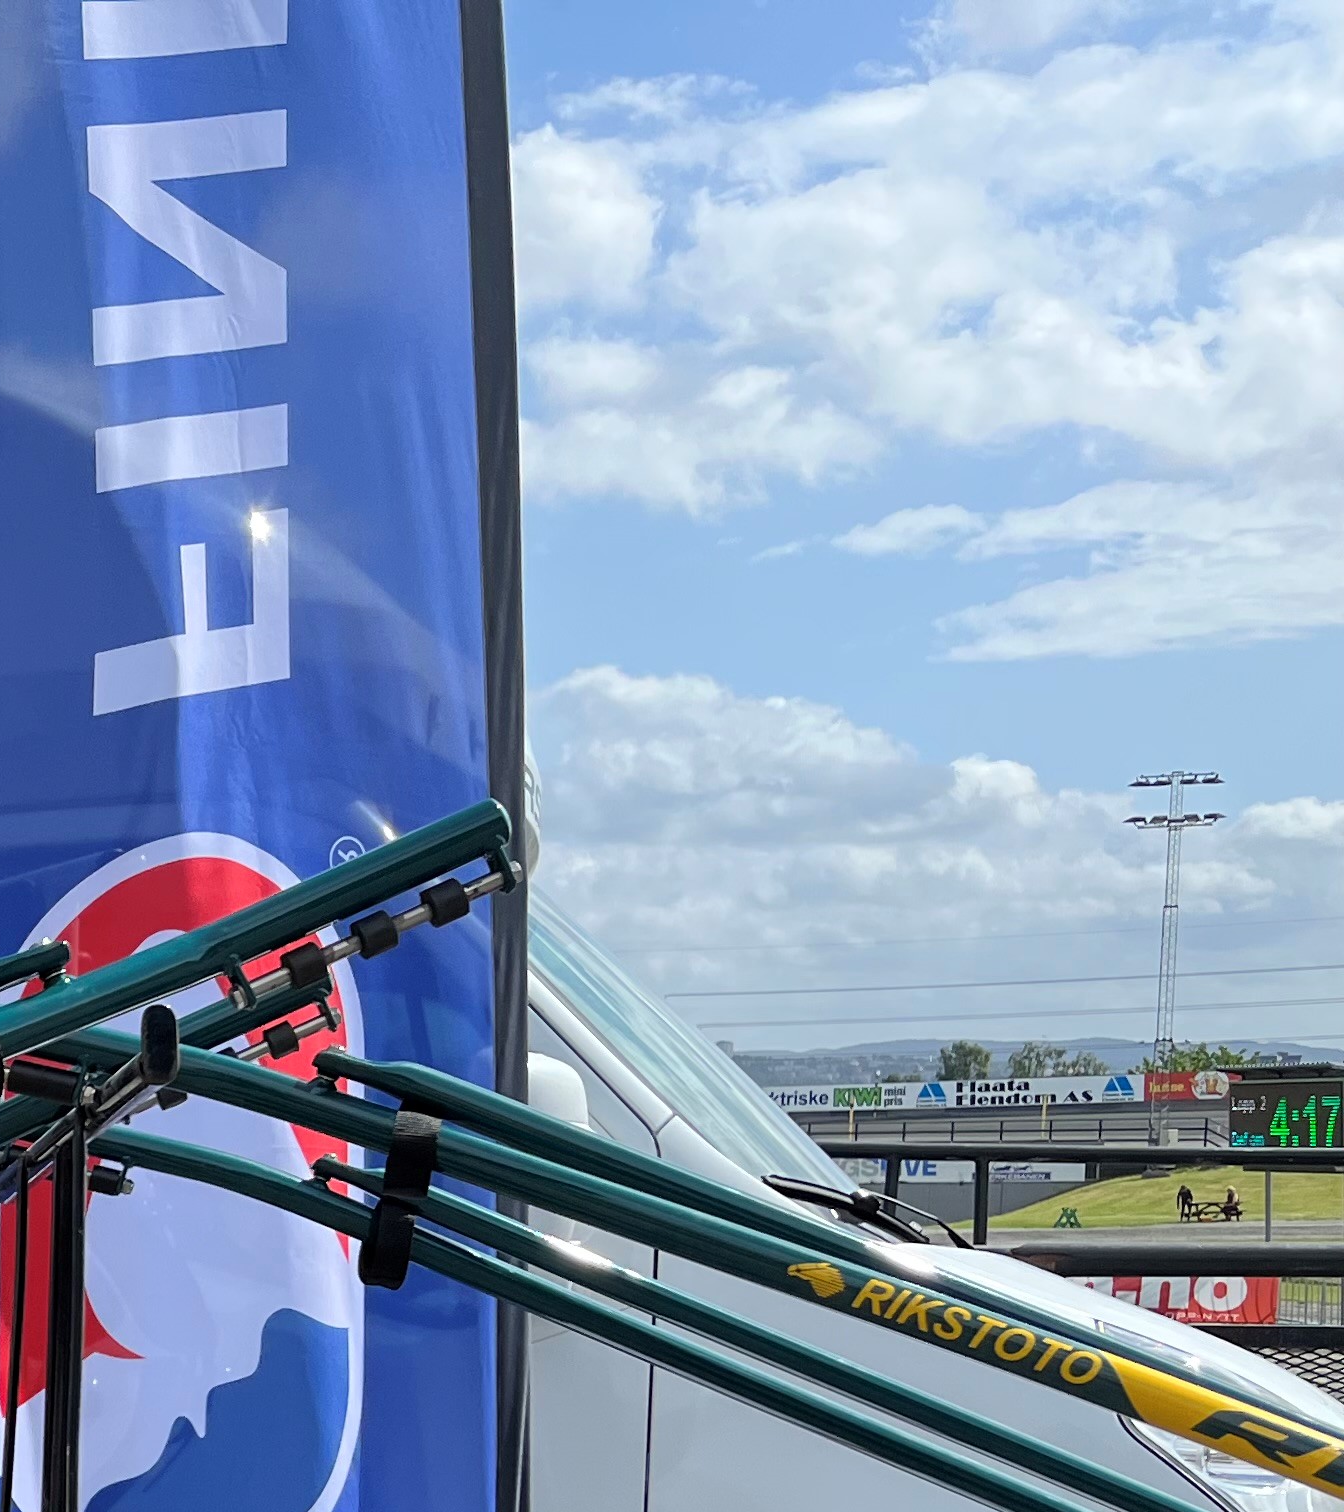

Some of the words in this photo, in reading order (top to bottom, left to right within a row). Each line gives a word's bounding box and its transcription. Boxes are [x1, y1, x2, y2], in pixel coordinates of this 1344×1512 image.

[833, 1087, 882, 1107] KIWI
[884, 1086, 907, 1096] mini
[1063, 1090, 1093, 1103] AS
[1270, 1095, 1341, 1147] 4:17
[851, 1276, 1104, 1386] RIKSTOTO
